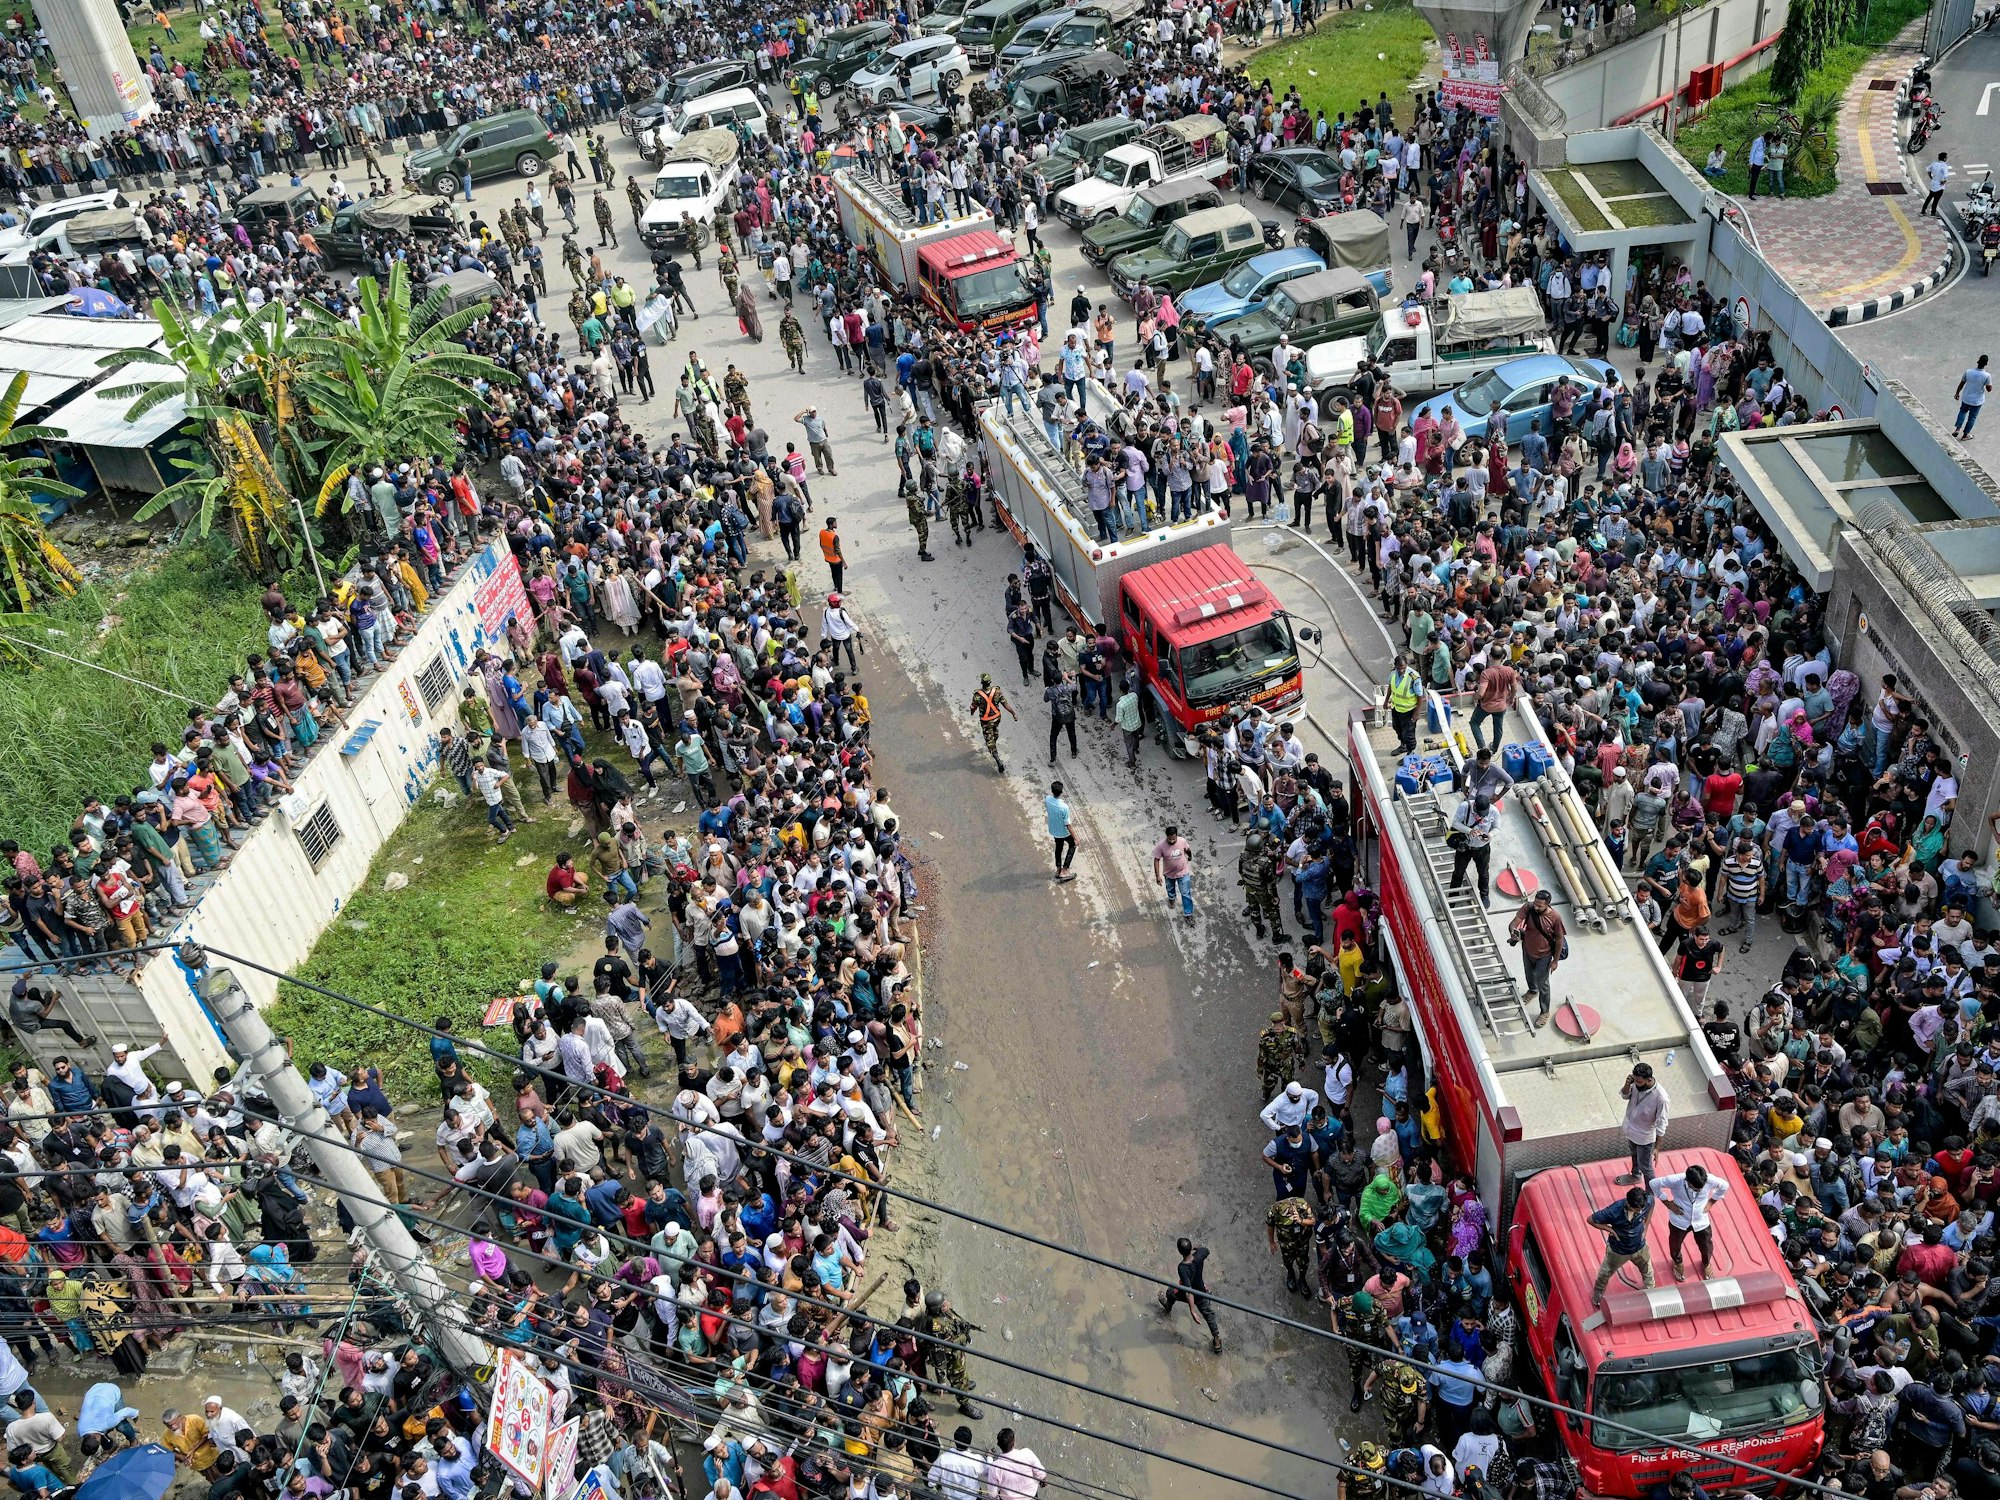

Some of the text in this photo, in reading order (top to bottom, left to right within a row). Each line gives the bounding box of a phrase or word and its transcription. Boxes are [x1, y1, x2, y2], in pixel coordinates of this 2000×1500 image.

[1257, 681, 1291, 701] RESPONSE
[1205, 708, 1221, 717] FIRE
[496, 1364, 509, 1418] UCC
[1631, 1454, 1657, 1464] FIRE
[1660, 1452, 1669, 1461] &
[1671, 1444, 1718, 1460] RESUE
[1721, 1437, 1782, 1453] RESPONSE
